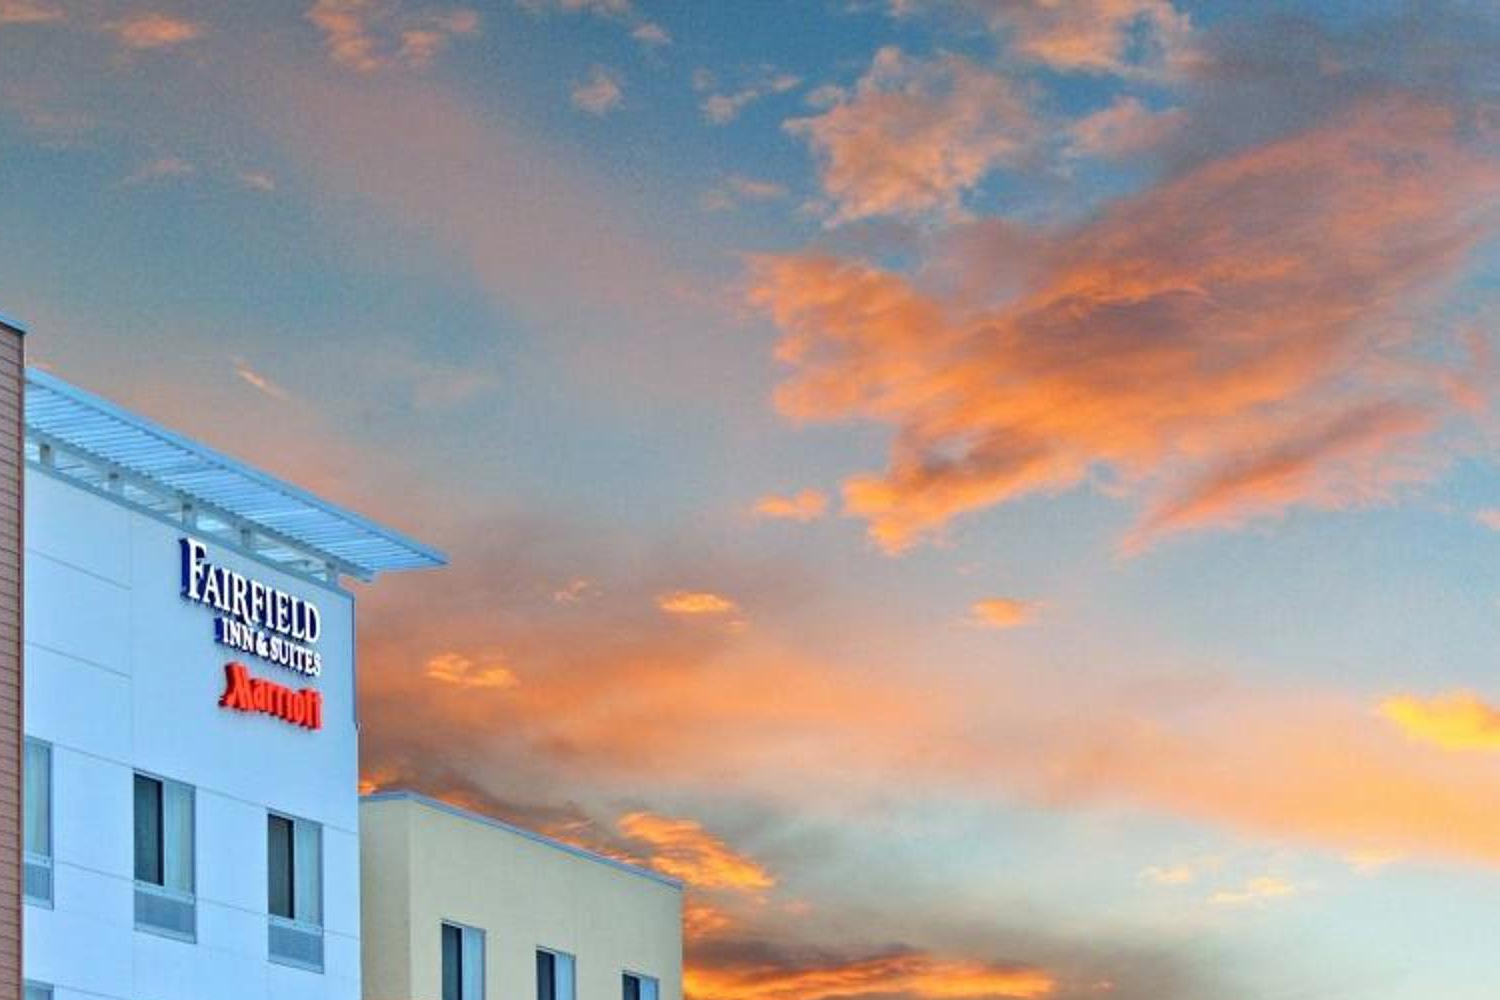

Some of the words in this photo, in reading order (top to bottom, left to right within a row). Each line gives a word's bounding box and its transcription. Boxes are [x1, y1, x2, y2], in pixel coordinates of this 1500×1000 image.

[183, 537, 321, 643] FAIRFIELD
[220, 617, 254, 651] INN
[270, 636, 322, 678] SUITES
[220, 662, 323, 730] Marriott
